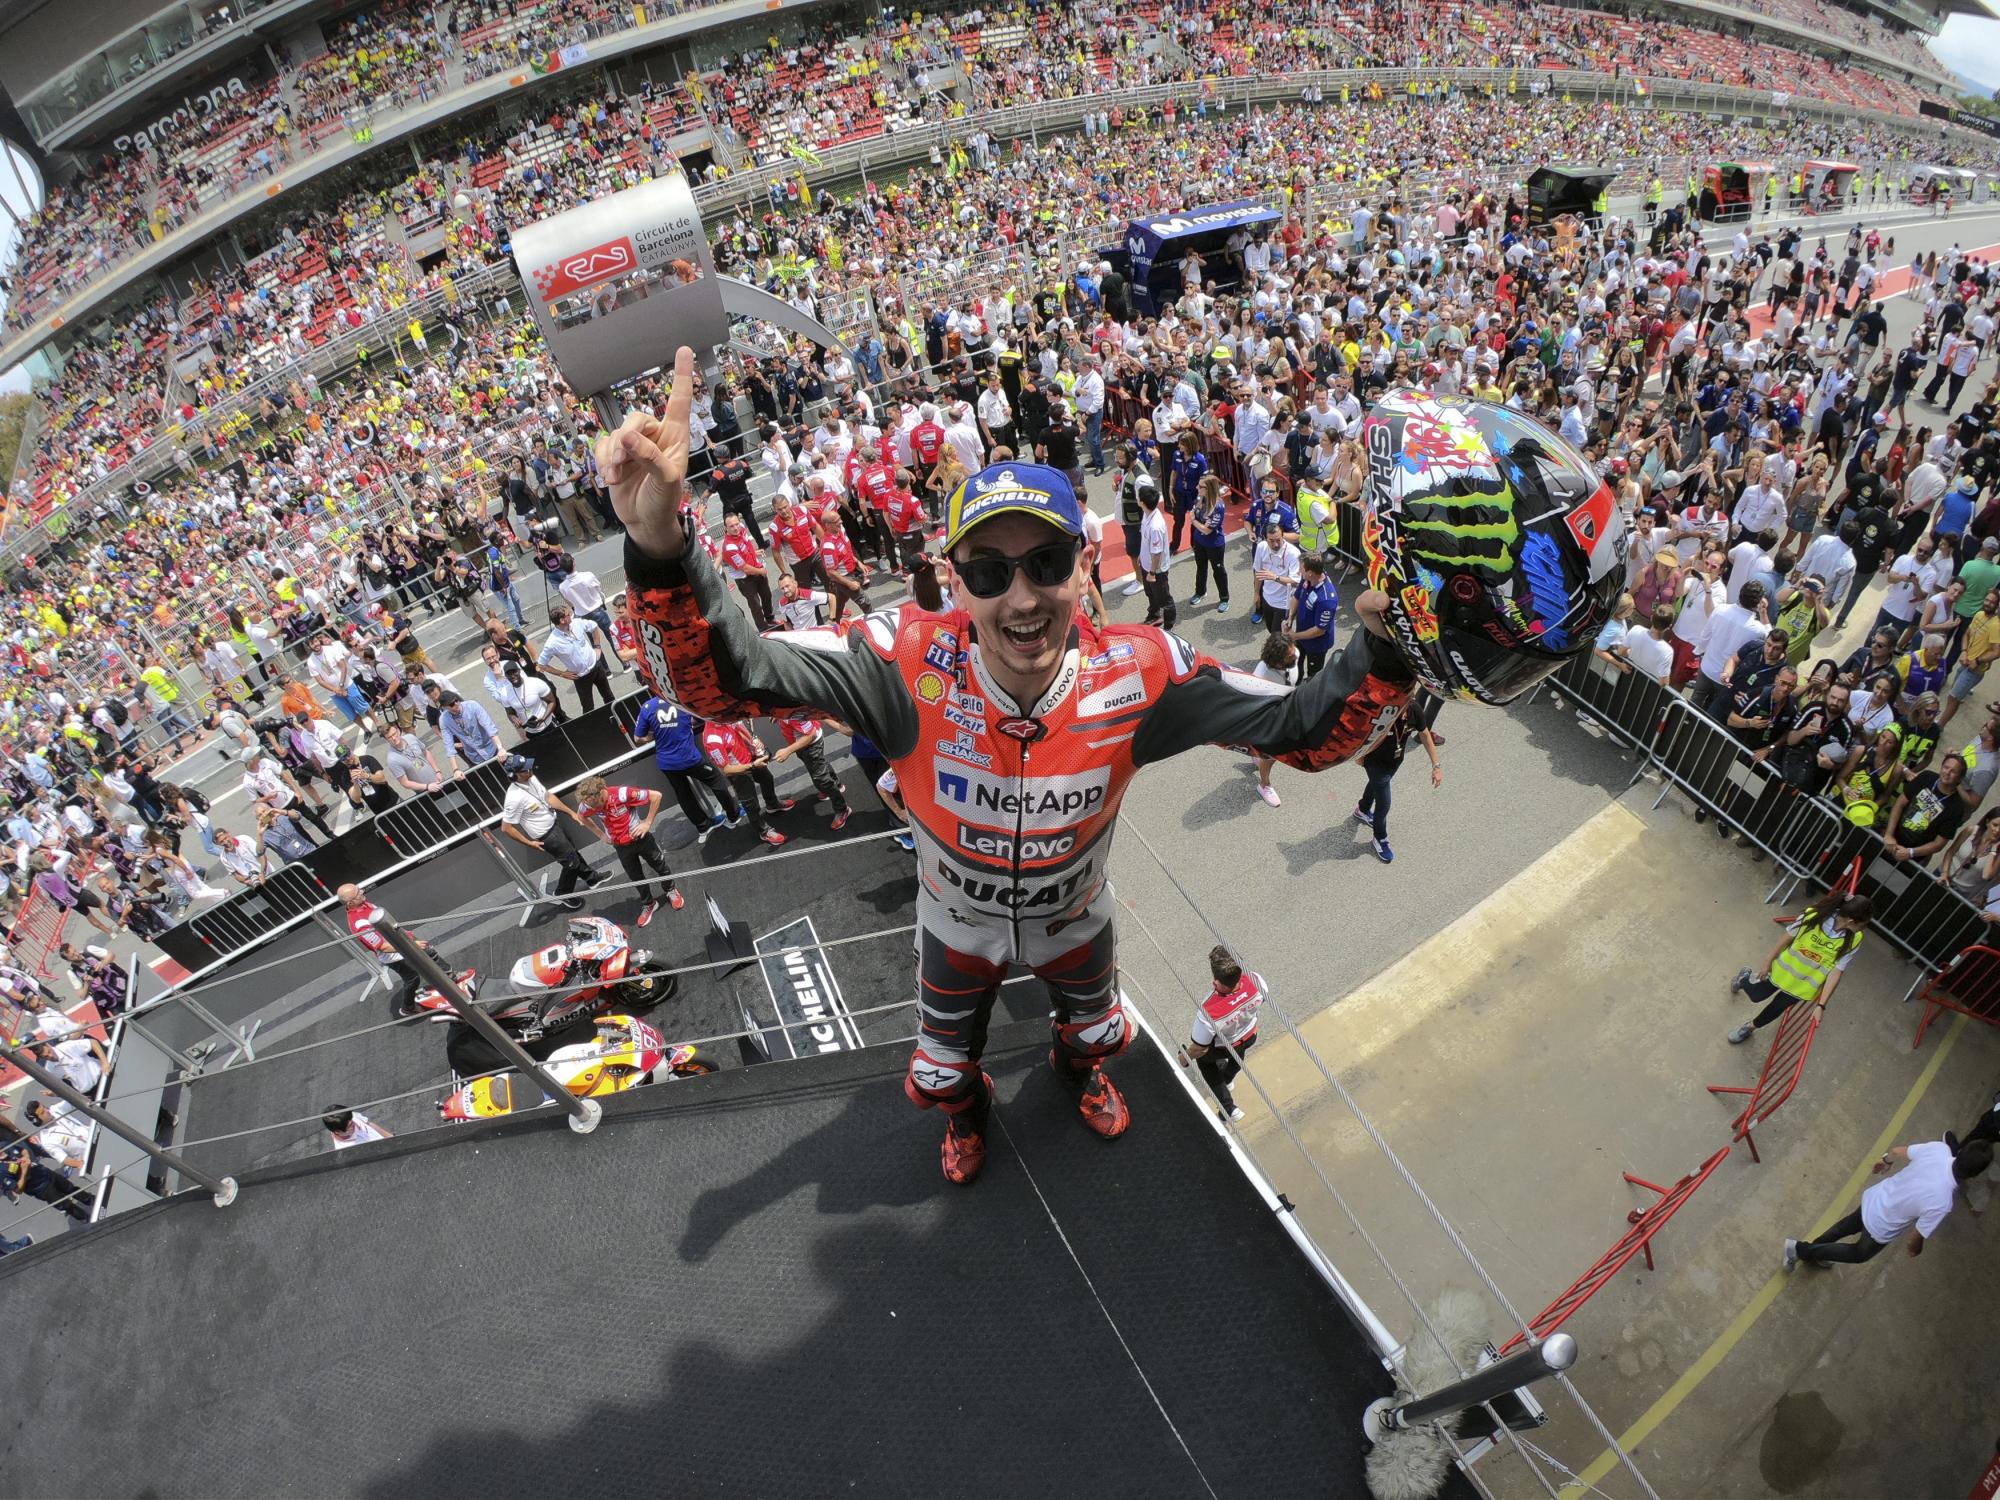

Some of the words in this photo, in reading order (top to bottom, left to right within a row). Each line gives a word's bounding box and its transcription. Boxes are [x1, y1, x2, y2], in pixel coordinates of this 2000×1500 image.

[635, 222, 675, 243] Circuit
[677, 216, 691, 229] de
[1193, 205, 1268, 226] movistar
[638, 228, 695, 255] Barcelona
[641, 239, 698, 265] CATALUNYA
[962, 491, 1049, 521] MICHELIN
[1368, 423, 1408, 584] SHARK
[1040, 667, 1074, 714] Lenovo
[1104, 691, 1142, 709] DUCATI
[938, 740, 992, 768] SHARK
[976, 784, 1103, 815] NetApp
[960, 824, 1074, 861] Lenovo
[938, 856, 1094, 908] DUCATI
[550, 1001, 598, 1027] DUCATI
[781, 946, 841, 1053] ICHELIN
